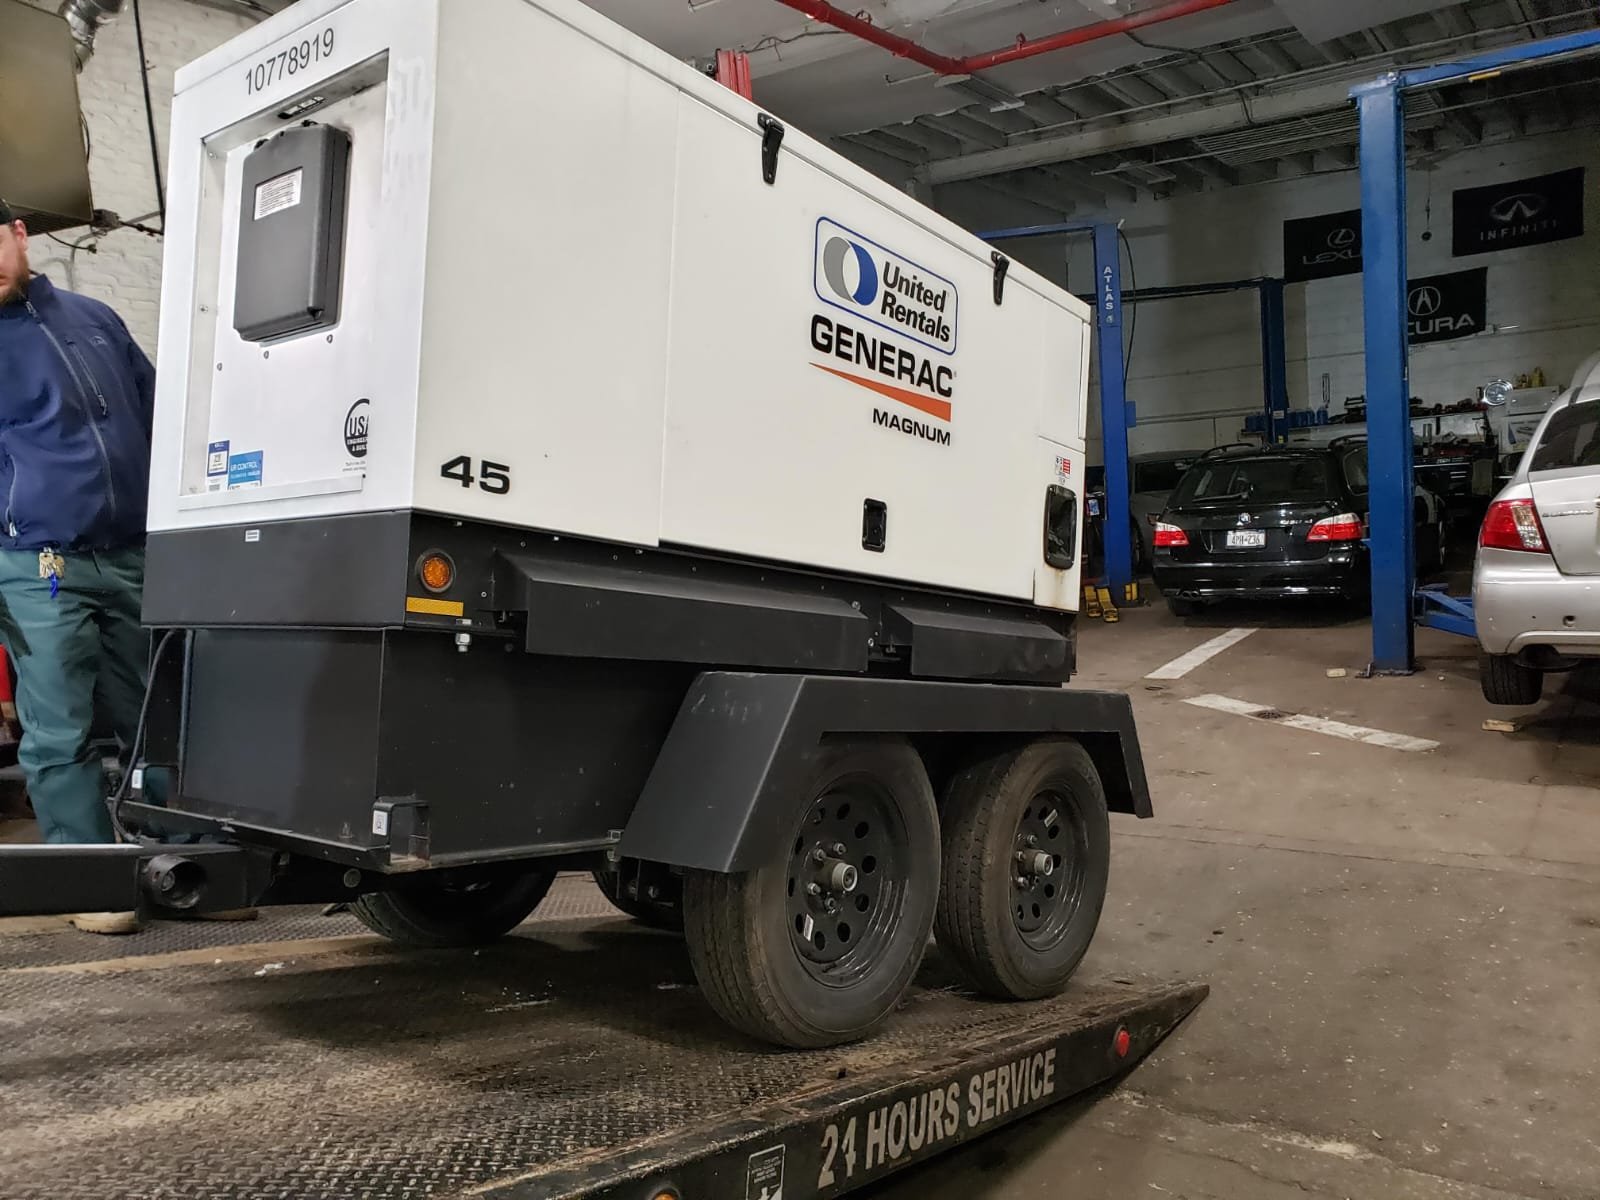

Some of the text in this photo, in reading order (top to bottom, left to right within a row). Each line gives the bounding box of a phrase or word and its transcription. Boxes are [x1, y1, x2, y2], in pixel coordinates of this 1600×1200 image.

[245, 27, 335, 95] 10778919
[1480, 219, 1557, 241] INFINITI
[883, 261, 947, 313] United
[1103, 266, 1114, 310] ATLAS
[881, 291, 951, 343] Rentals
[810, 314, 953, 398] GENERAC
[872, 408, 951, 446] MAGNUM
[440, 455, 511, 495] 45
[865, 1082, 961, 1170] HOURS
[967, 1048, 1057, 1128] SERVICE
